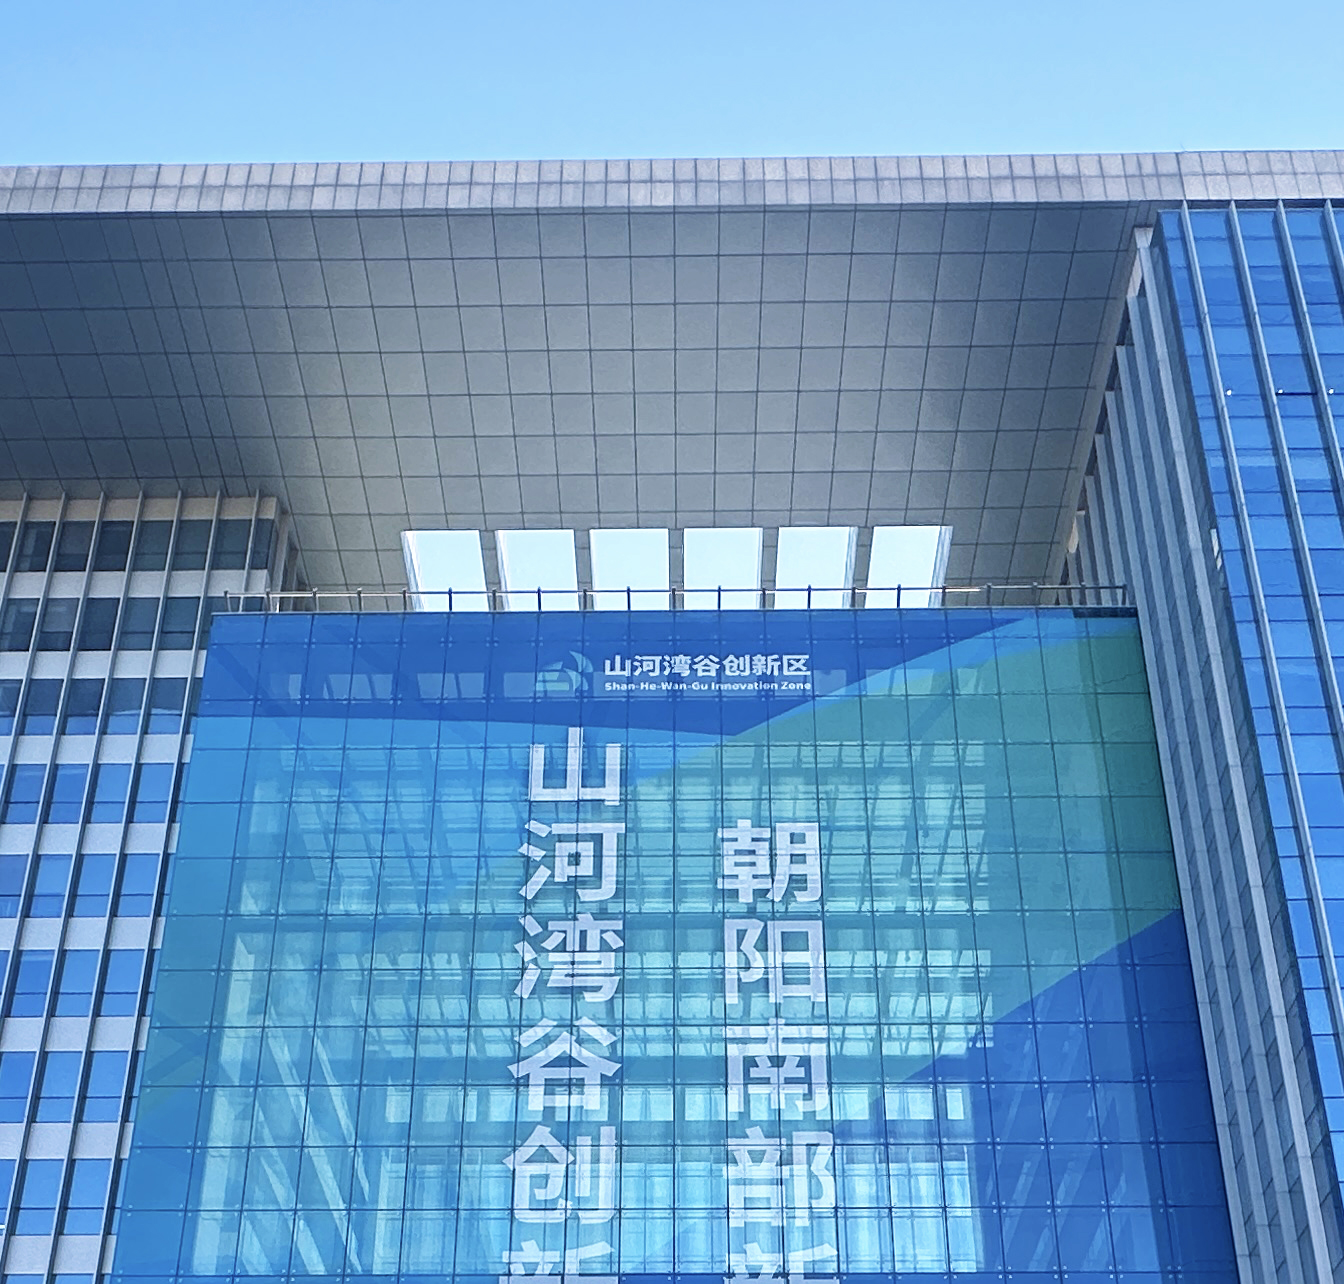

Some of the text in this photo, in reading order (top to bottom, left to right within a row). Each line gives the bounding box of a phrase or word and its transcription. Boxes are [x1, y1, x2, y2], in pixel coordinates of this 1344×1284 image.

[604, 654, 811, 677] 山河湾谷创新区
[604, 681, 812, 692] Shan-He-Wan-Gu Innovation Zone
